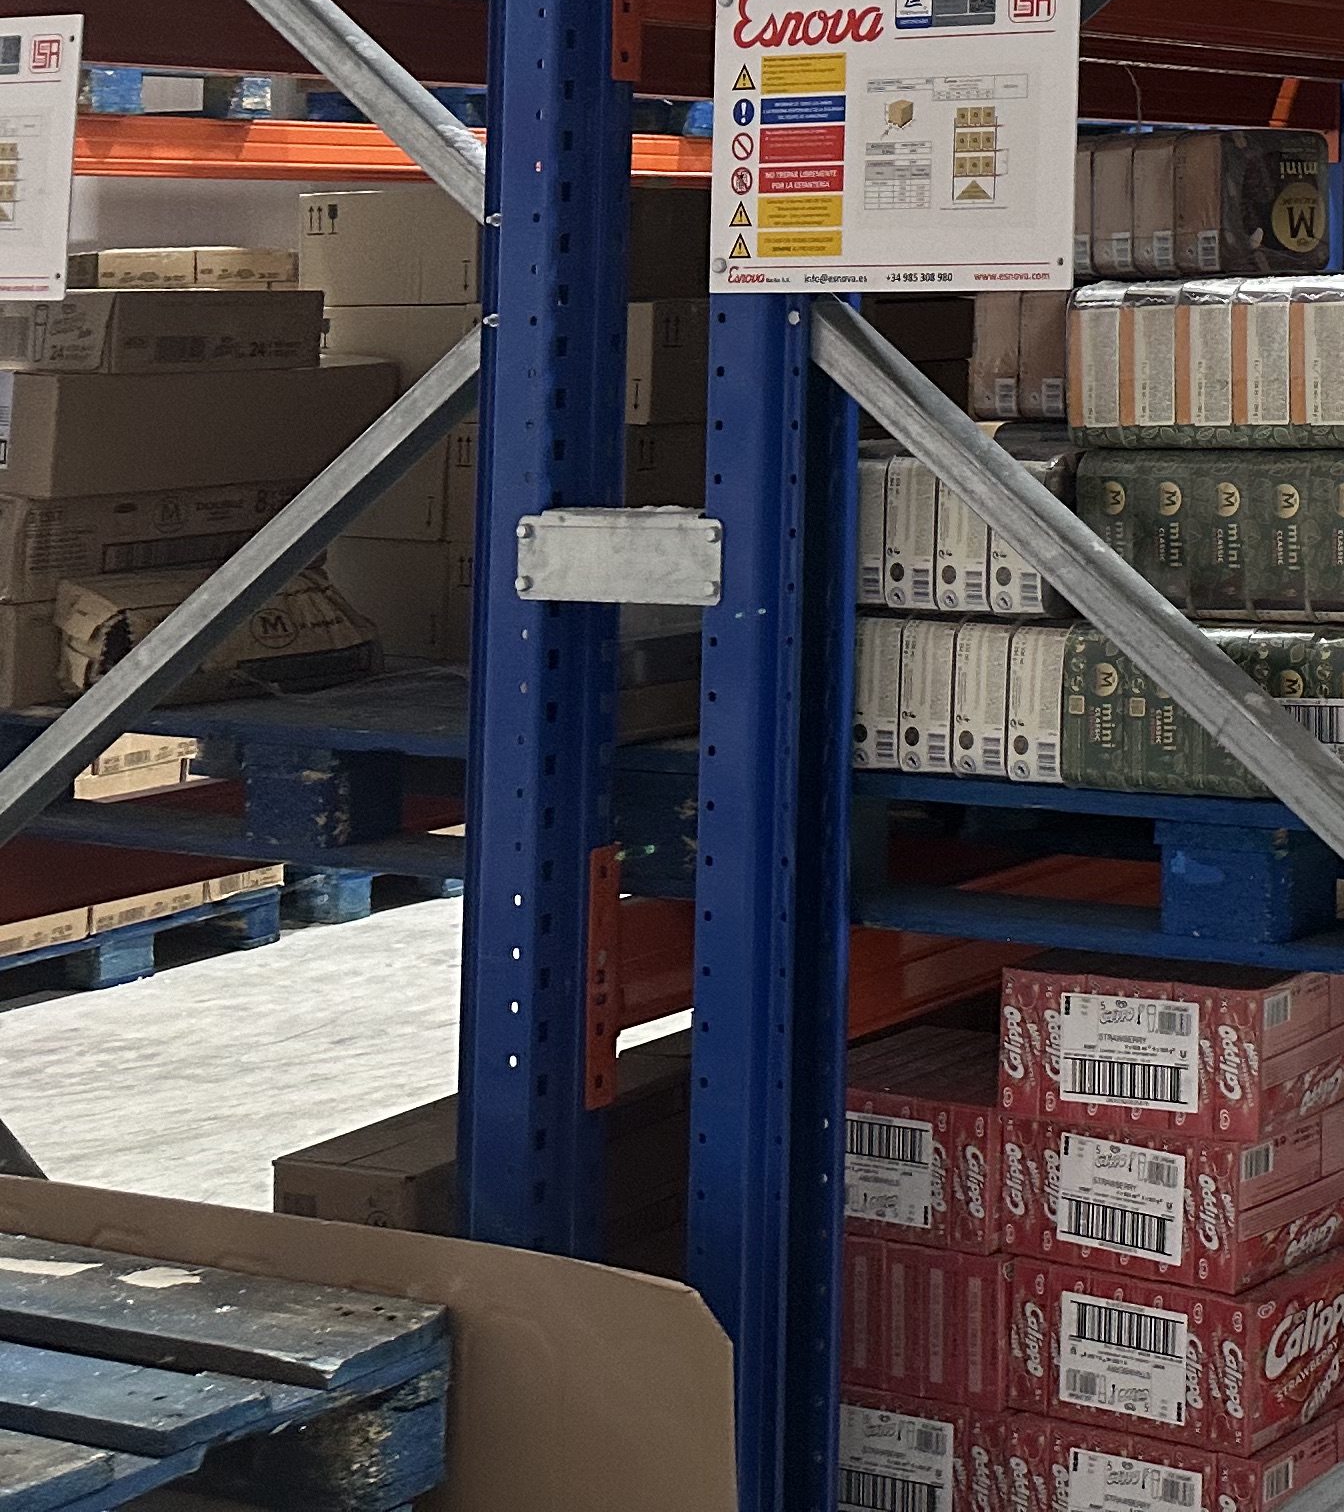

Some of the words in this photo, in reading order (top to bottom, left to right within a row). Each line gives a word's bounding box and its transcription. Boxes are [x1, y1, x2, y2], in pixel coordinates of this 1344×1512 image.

[1280, 161, 1319, 180] mini
[1287, 206, 1315, 239] M
[728, 266, 766, 284] Esnova
[886, 273, 901, 283] +34
[903, 273, 918, 283] 985
[937, 273, 953, 283] 980
[1165, 491, 1177, 507] M
[1222, 491, 1235, 508] M
[1281, 493, 1295, 509] M
[1169, 522, 1182, 567] mini
[1228, 523, 1240, 569] mini
[1287, 524, 1300, 570] mini
[259, 615, 289, 637] M
[1101, 671, 1114, 687] M
[1285, 678, 1298, 693] M
[1102, 704, 1115, 748] mini
[1163, 705, 1176, 751] mini
[1100, 1001, 1106, 1010] 5
[1003, 1005, 1025, 1079] Calippo
[1099, 1033, 1147, 1044] STRAWBERRY
[1218, 1025, 1242, 1100] Calippo
[1005, 1142, 1025, 1215] Calippo
[1093, 1176, 1136, 1191] STRAWBERRY
[1199, 1174, 1219, 1250] Calippo
[1024, 1302, 1044, 1377] Calippo
[1223, 1340, 1243, 1419] Calippo
[1274, 1338, 1340, 1404] STRAWBERRY
